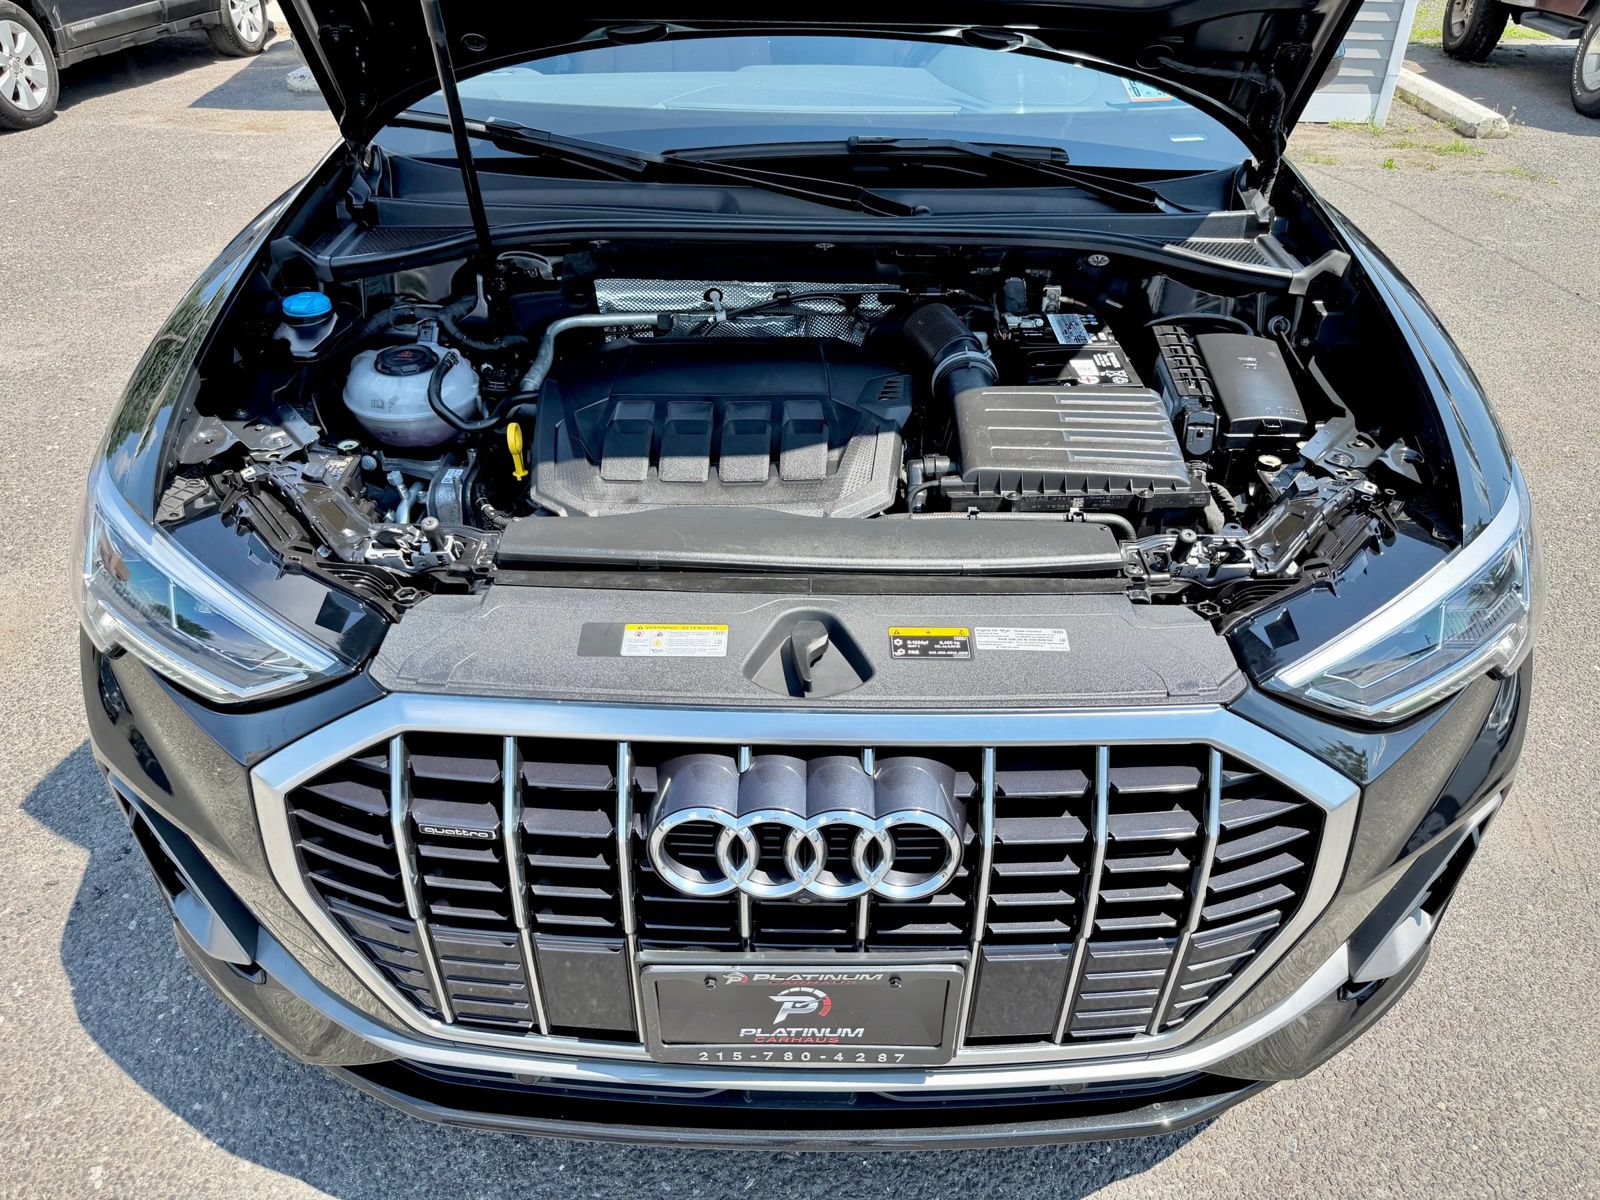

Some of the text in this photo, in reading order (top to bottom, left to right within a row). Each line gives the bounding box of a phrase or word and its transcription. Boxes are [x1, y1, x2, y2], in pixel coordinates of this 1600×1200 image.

[424, 827, 489, 838] quattro
[752, 973, 884, 981] PLATINUM
[739, 1028, 865, 1038] PLATINUM
[754, 1036, 840, 1044] CARHAUS
[699, 1052, 905, 1063] 215-780-4287
